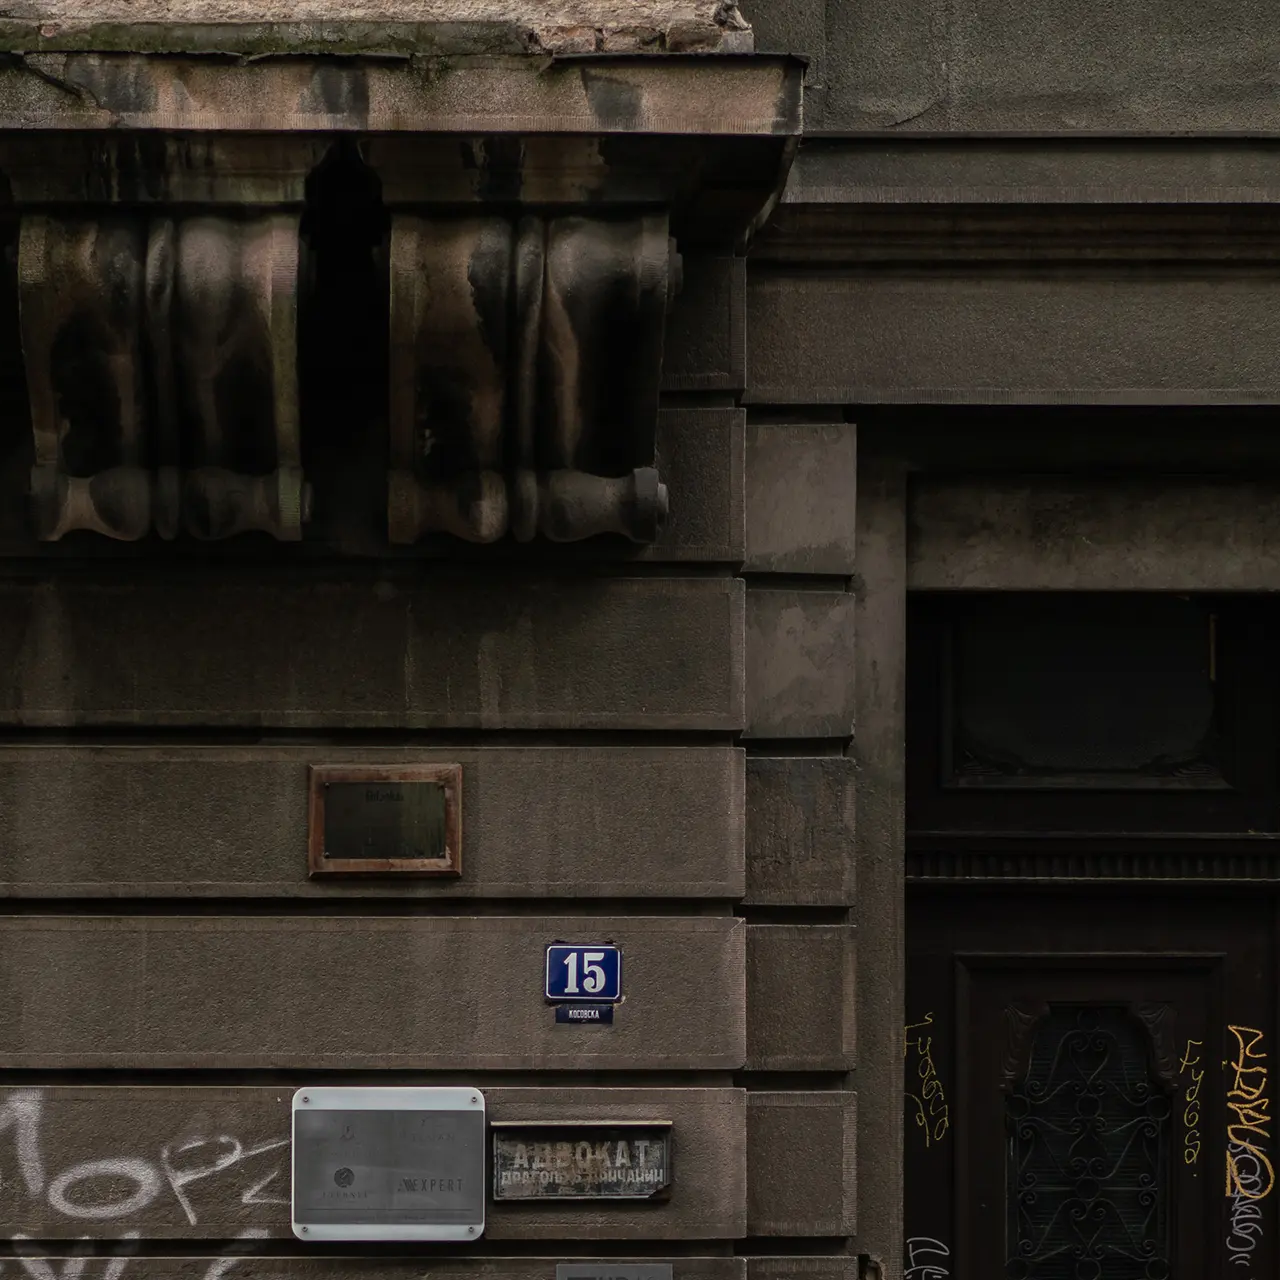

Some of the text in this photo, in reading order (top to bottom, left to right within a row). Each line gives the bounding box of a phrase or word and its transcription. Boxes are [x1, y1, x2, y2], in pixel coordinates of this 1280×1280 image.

[564, 951, 607, 995] 15
[568, 1009, 600, 1019] КОСОВСКА
[513, 1140, 651, 1170] АДВОКАТ
